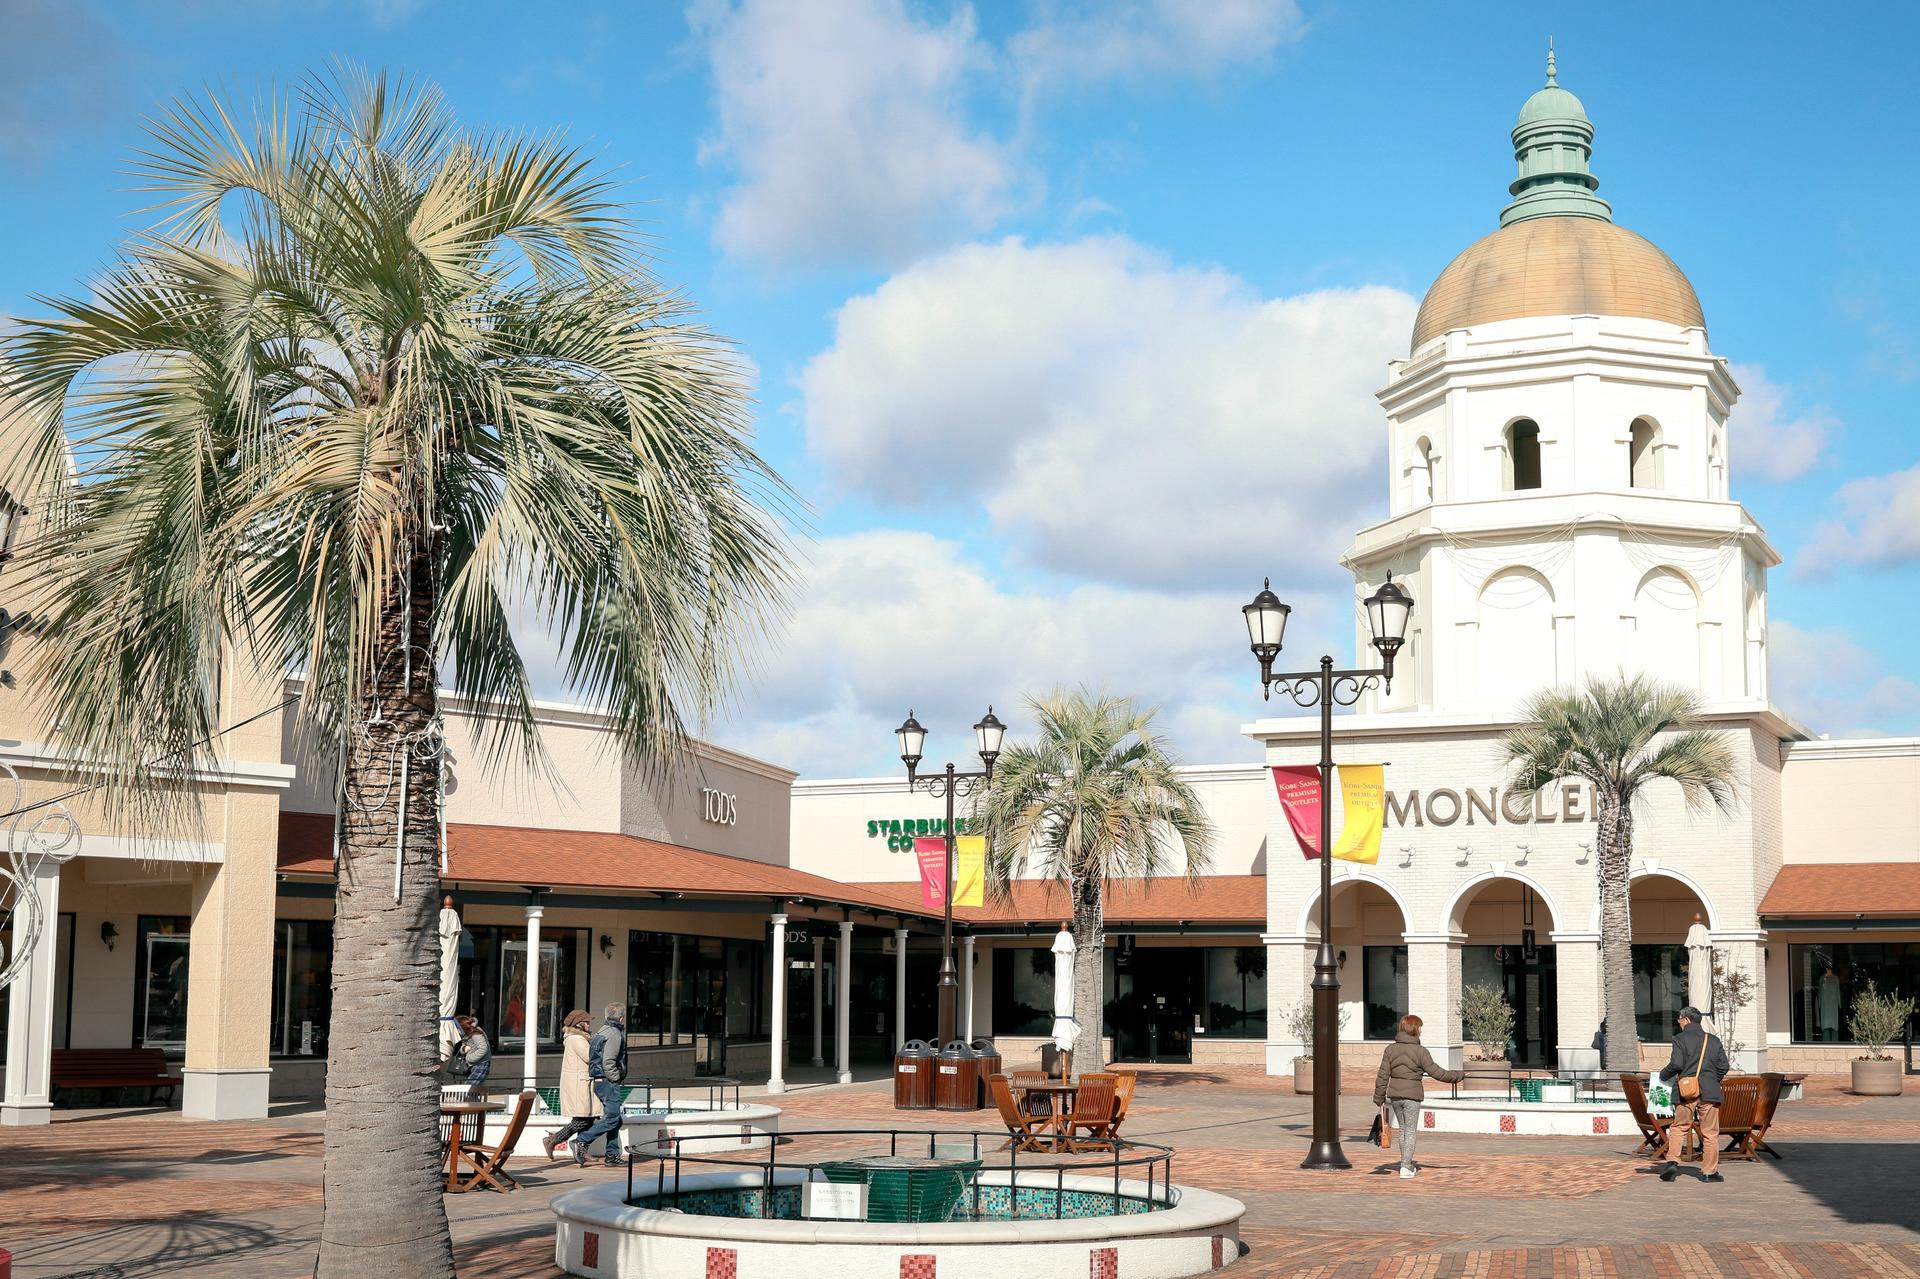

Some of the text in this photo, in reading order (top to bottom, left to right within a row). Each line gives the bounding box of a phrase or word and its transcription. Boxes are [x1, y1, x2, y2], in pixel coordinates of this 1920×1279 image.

[1286, 789, 1318, 799] PREMIUM
[703, 787, 737, 826] TOD'S
[1289, 797, 1319, 807] OUTLETS
